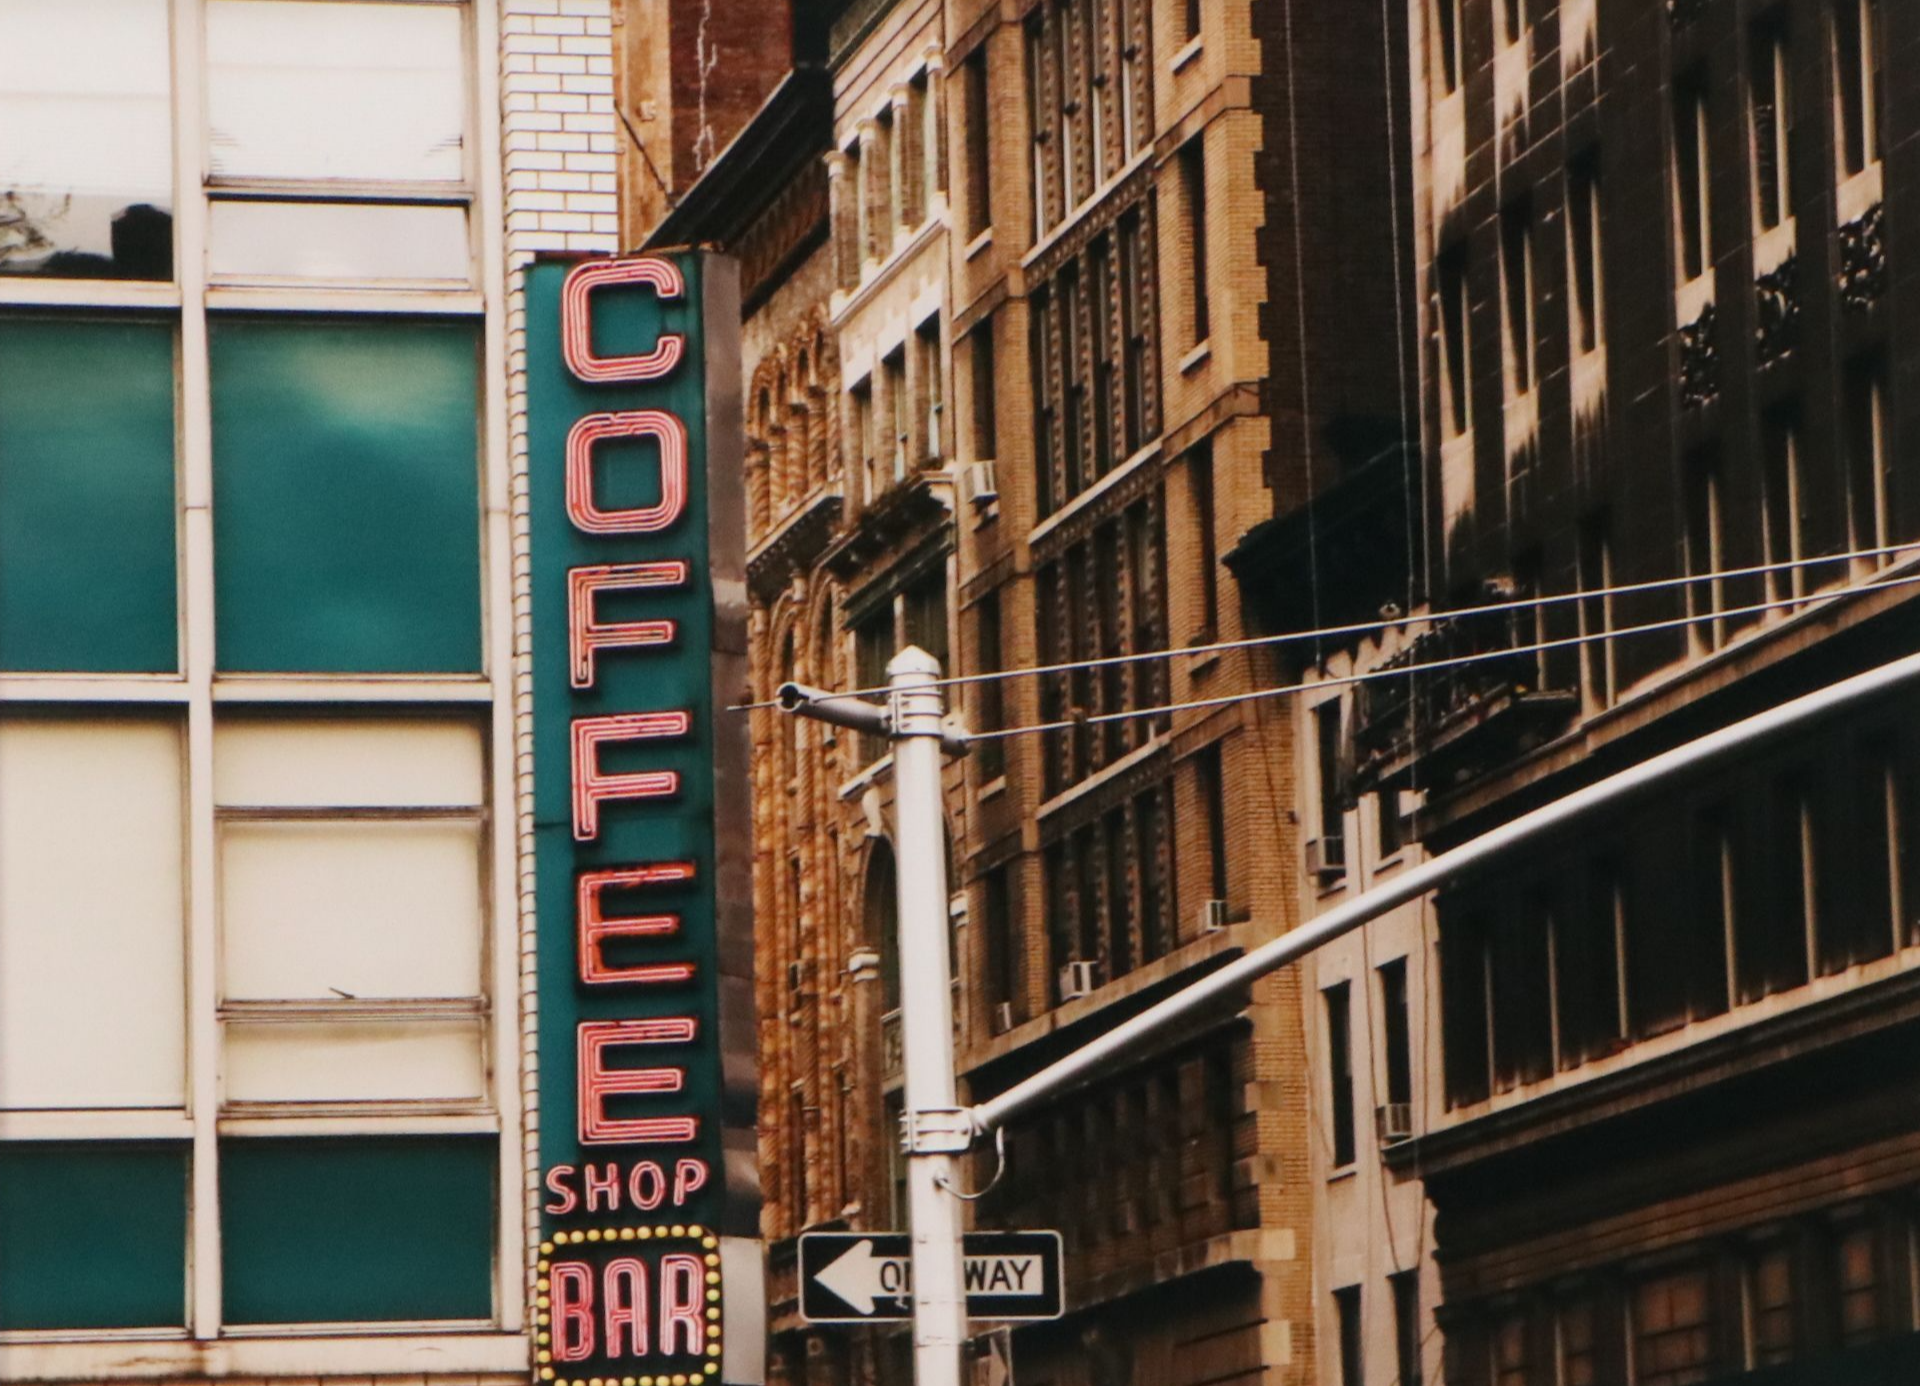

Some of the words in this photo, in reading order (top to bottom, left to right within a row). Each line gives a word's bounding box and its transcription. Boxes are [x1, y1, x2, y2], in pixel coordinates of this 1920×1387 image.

[561, 257, 697, 1145] COFFEE
[545, 1159, 708, 1214] SHOP
[549, 1253, 704, 1361] BAR
[964, 1259, 1032, 1292] WAY
